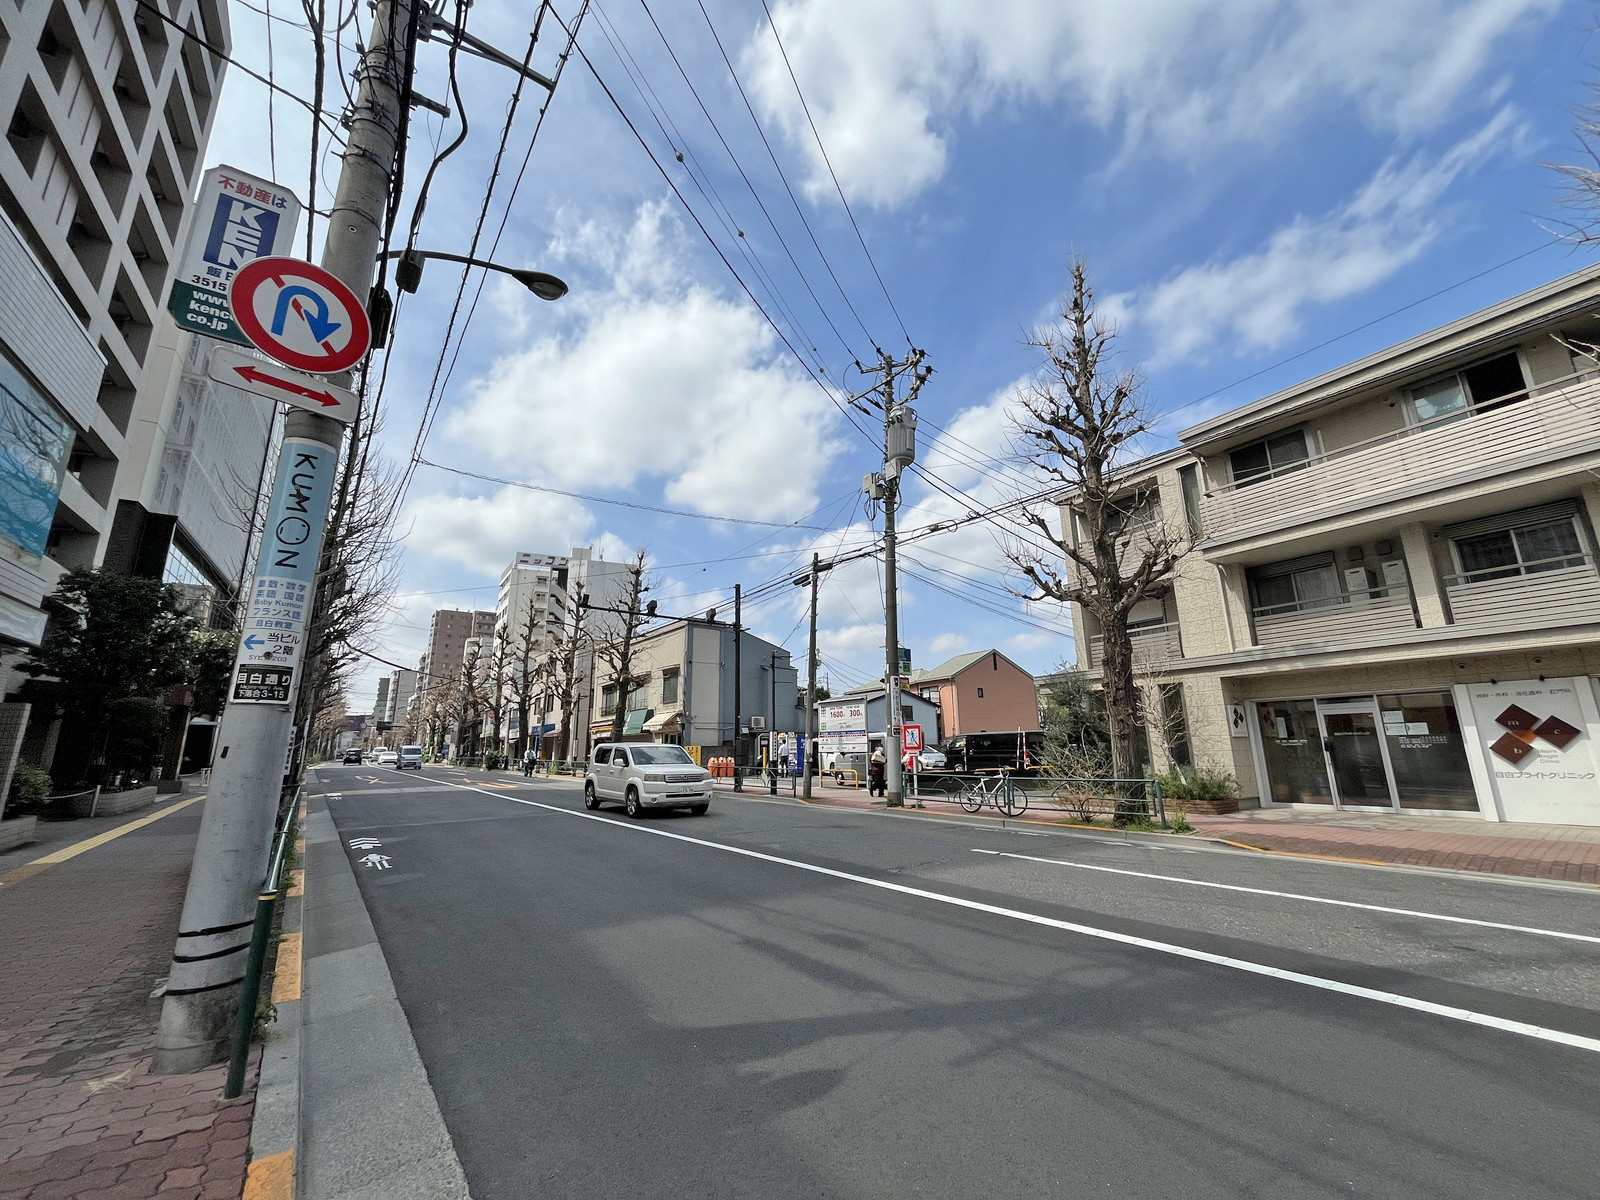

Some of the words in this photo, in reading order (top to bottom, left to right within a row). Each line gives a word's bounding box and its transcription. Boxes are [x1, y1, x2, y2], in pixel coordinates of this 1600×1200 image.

[218, 174, 289, 210] 不動産は
[191, 274, 227, 292] 3515
[186, 312, 228, 331] co.jp
[274, 452, 319, 569] KUMON
[520, 553, 569, 566] ニッコン
[254, 598, 273, 607] Baby
[275, 599, 303, 610] Kumon
[252, 607, 302, 620] フランス語
[267, 632, 300, 645] 当ビル
[237, 672, 291, 686] 目白通り
[238, 689, 285, 699] 下落合3-15
[849, 709, 861, 717] 300
